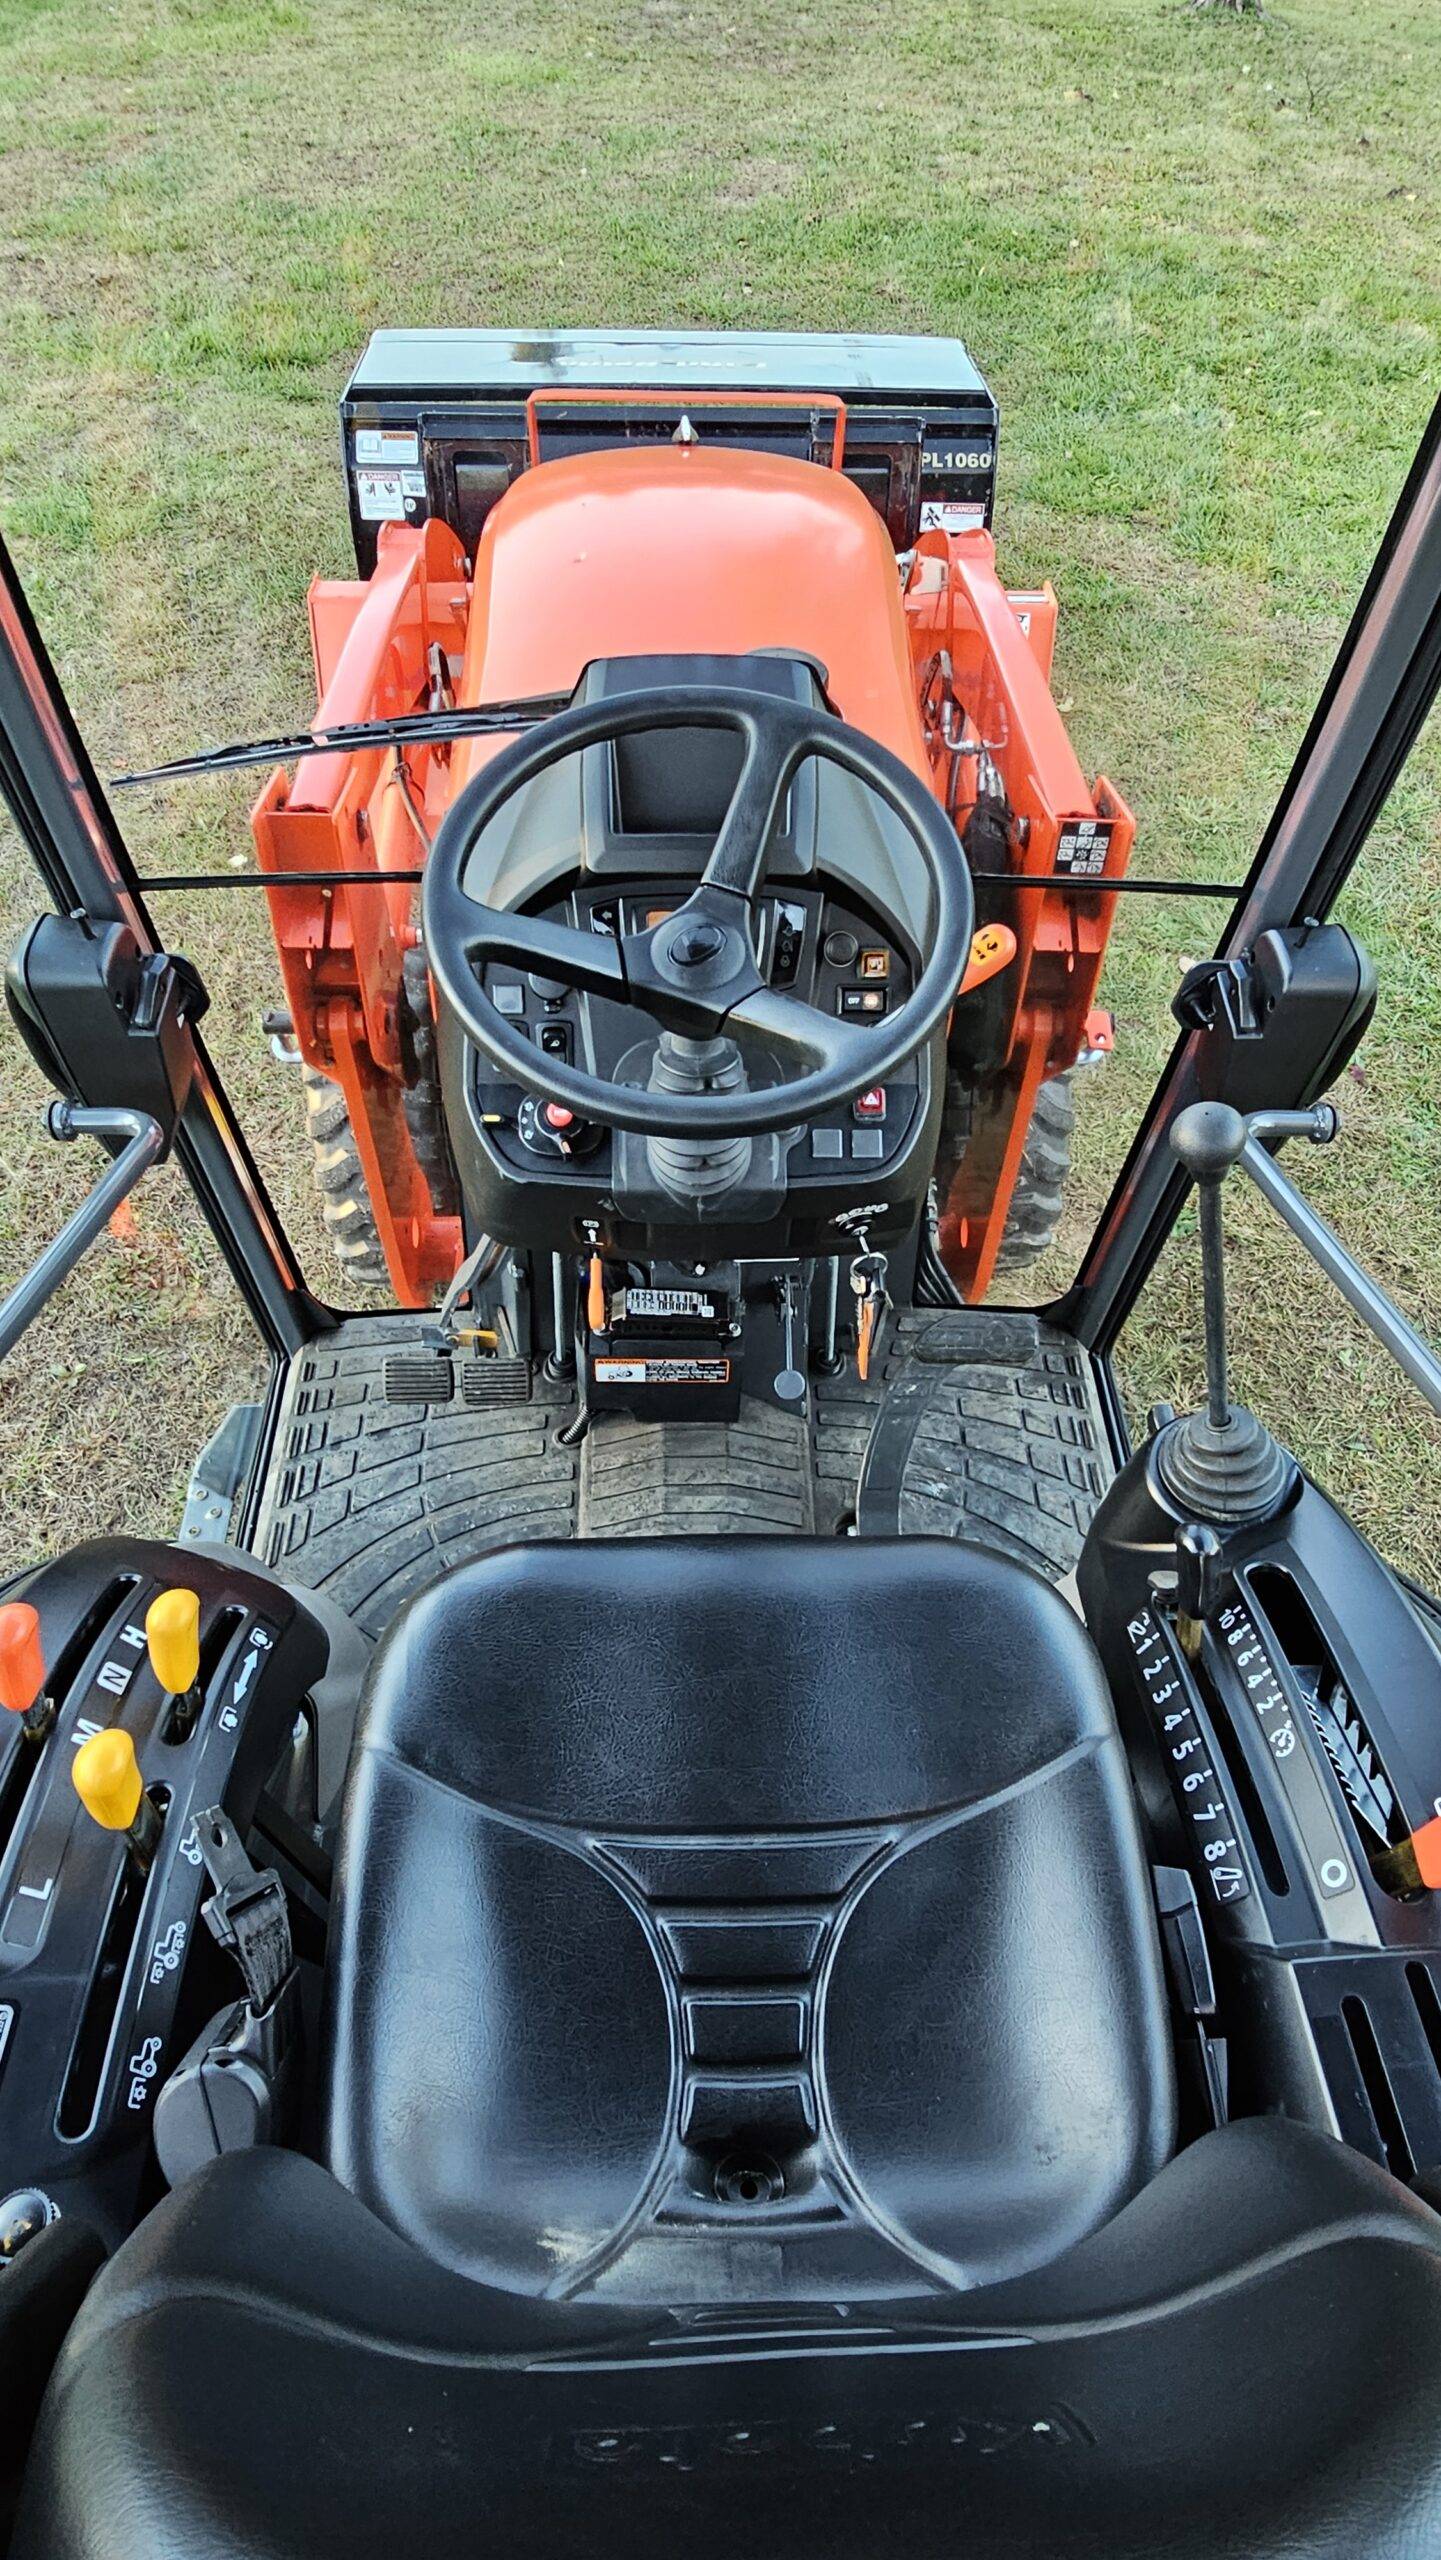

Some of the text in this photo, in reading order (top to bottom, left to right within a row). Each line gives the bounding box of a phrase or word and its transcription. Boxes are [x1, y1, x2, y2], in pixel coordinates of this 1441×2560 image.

[921, 452, 992, 468] PL1060
[951, 505, 982, 514] DANGER
[1218, 1608, 1235, 1629] 10
[120, 1624, 148, 1649] H
[1136, 1638, 1153, 1655] 1
[1227, 1629, 1243, 1645] 8
[1237, 1651, 1254, 1667] 6
[100, 1665, 129, 1691] N
[1143, 1659, 1162, 1680] 2
[1247, 1673, 1264, 1689] 4
[1152, 1684, 1172, 1704] 3
[1256, 1695, 1274, 1715] 2
[71, 1718, 104, 1746] M
[1164, 1714, 1183, 1731] 4
[1172, 1739, 1194, 1760] 5
[1182, 1772, 1205, 1792] 6
[1193, 1803, 1216, 1821] 7
[1204, 1840, 1226, 1861] 8
[19, 1878, 53, 1900] L
